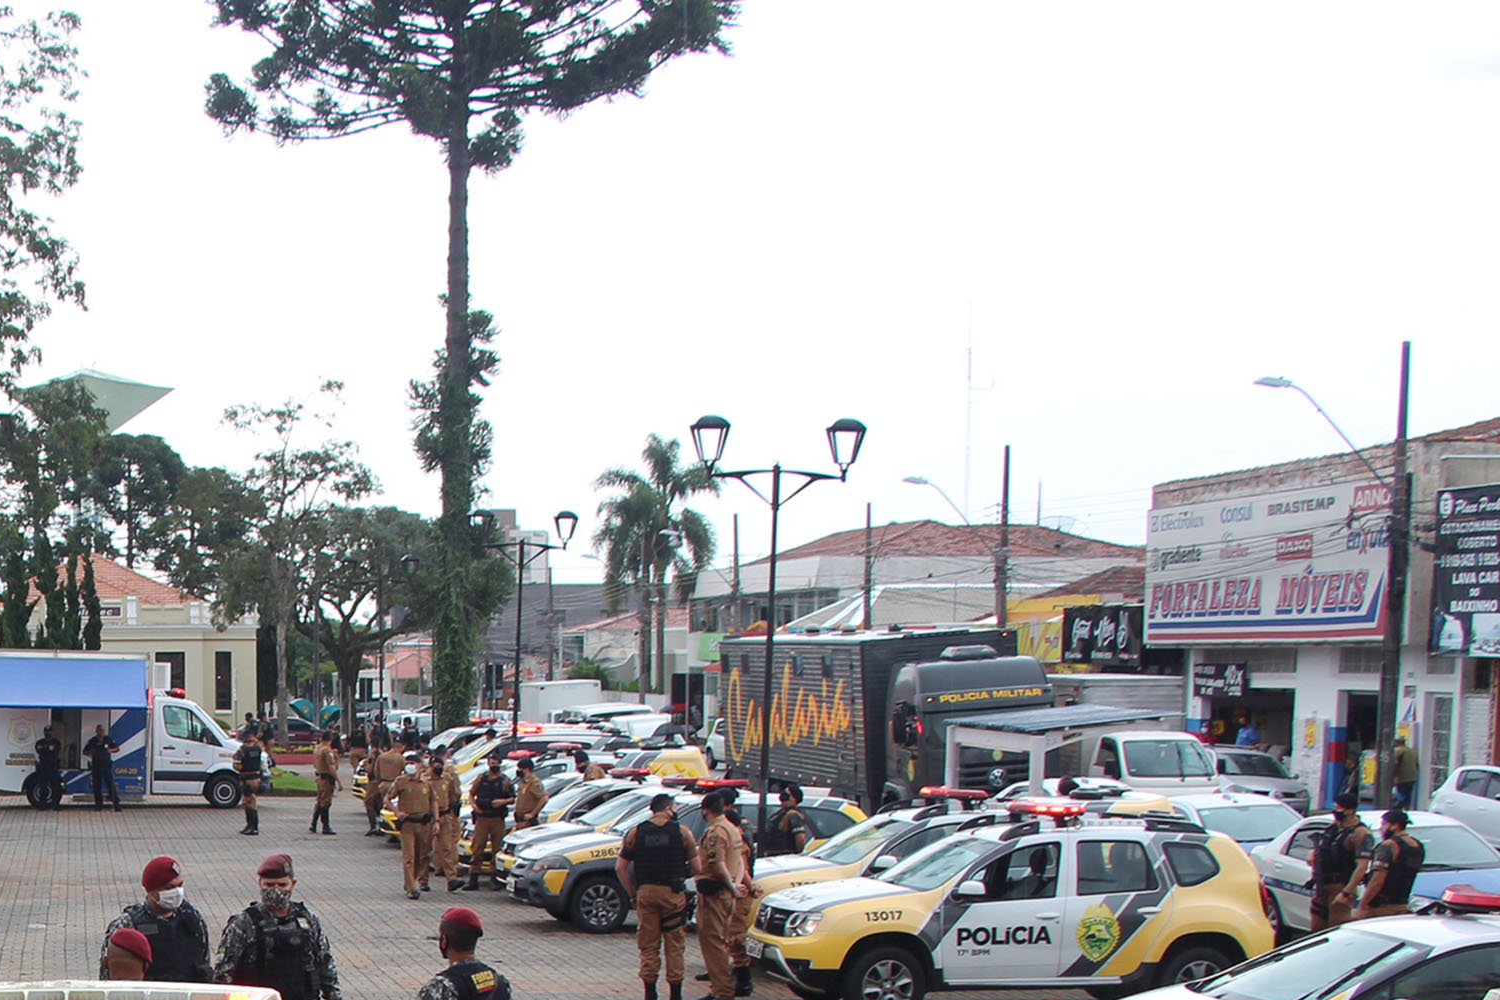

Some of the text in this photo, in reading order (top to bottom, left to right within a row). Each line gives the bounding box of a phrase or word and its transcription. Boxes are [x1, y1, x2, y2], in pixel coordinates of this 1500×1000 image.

[1354, 488, 1390, 506] ARNO
[1267, 497, 1335, 516] BRASTEMP
[1452, 571, 1499, 585] LAVA CAR
[1148, 565, 1369, 618] FORTALEZA MÓVEIS
[1450, 600, 1498, 612] BAIXINHO
[993, 687, 1042, 698] MILITAR
[865, 910, 903, 922] 13017
[956, 925, 1052, 946] POLÍCIA
